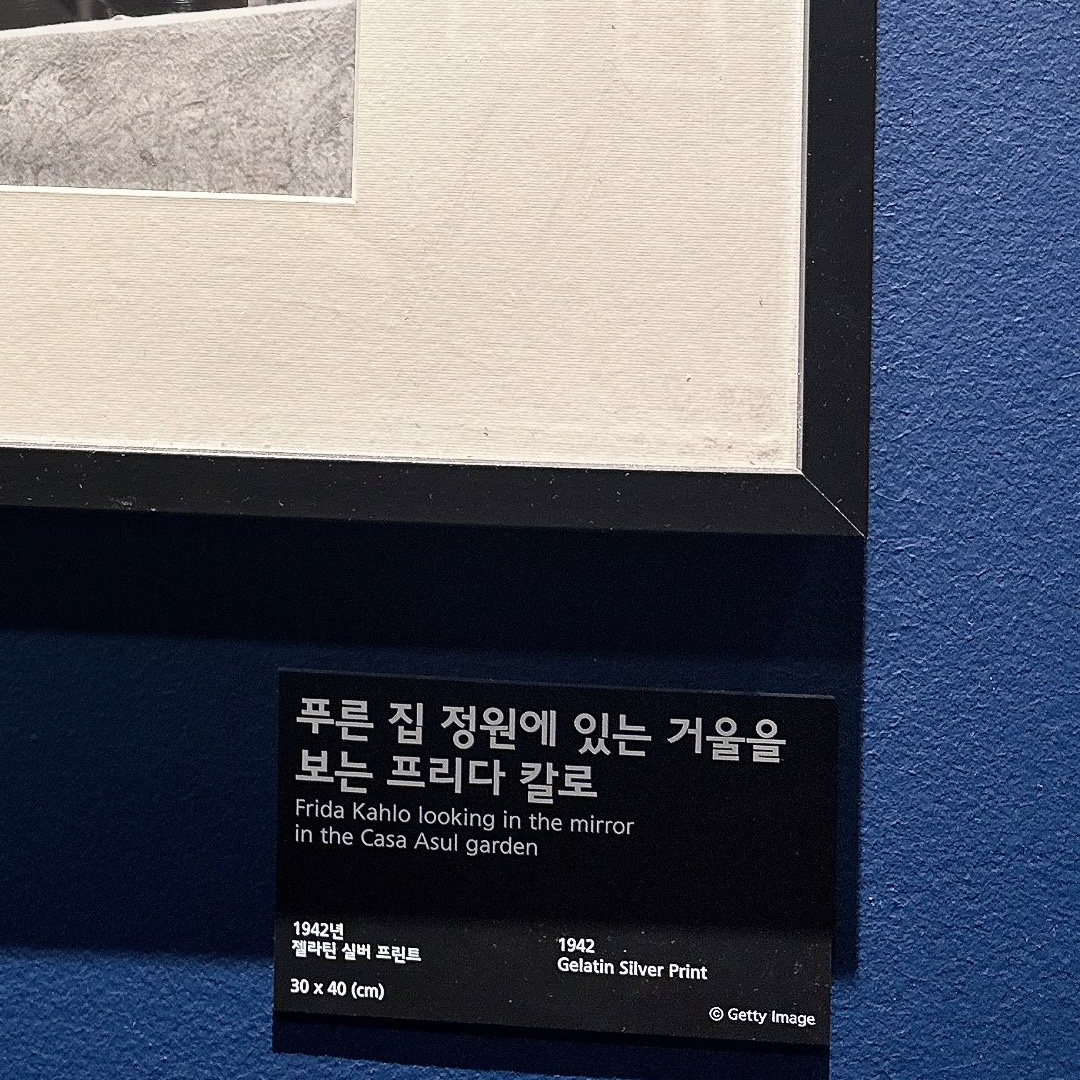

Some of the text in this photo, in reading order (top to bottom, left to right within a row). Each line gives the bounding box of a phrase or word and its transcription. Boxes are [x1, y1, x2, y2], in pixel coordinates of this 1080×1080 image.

[296, 697, 787, 764] 푸른 집 정원에 있는 거울을
[295, 749, 598, 805] 보는 프리다 칼로
[295, 798, 635, 835] Frida Kahlo looking in the mirror
[295, 823, 538, 857] in the Casa Asul garden
[292, 920, 344, 942] 1942년
[291, 939, 422, 964] 젤라틴 실버 프린트
[558, 937, 596, 954] 1942
[556, 956, 708, 980] Gelatin Silver Print
[290, 977, 310, 994] 30
[326, 980, 347, 997] 40
[350, 981, 385, 1001] (cm)
[727, 1007, 768, 1025] Getty
[771, 1009, 817, 1028] Image
